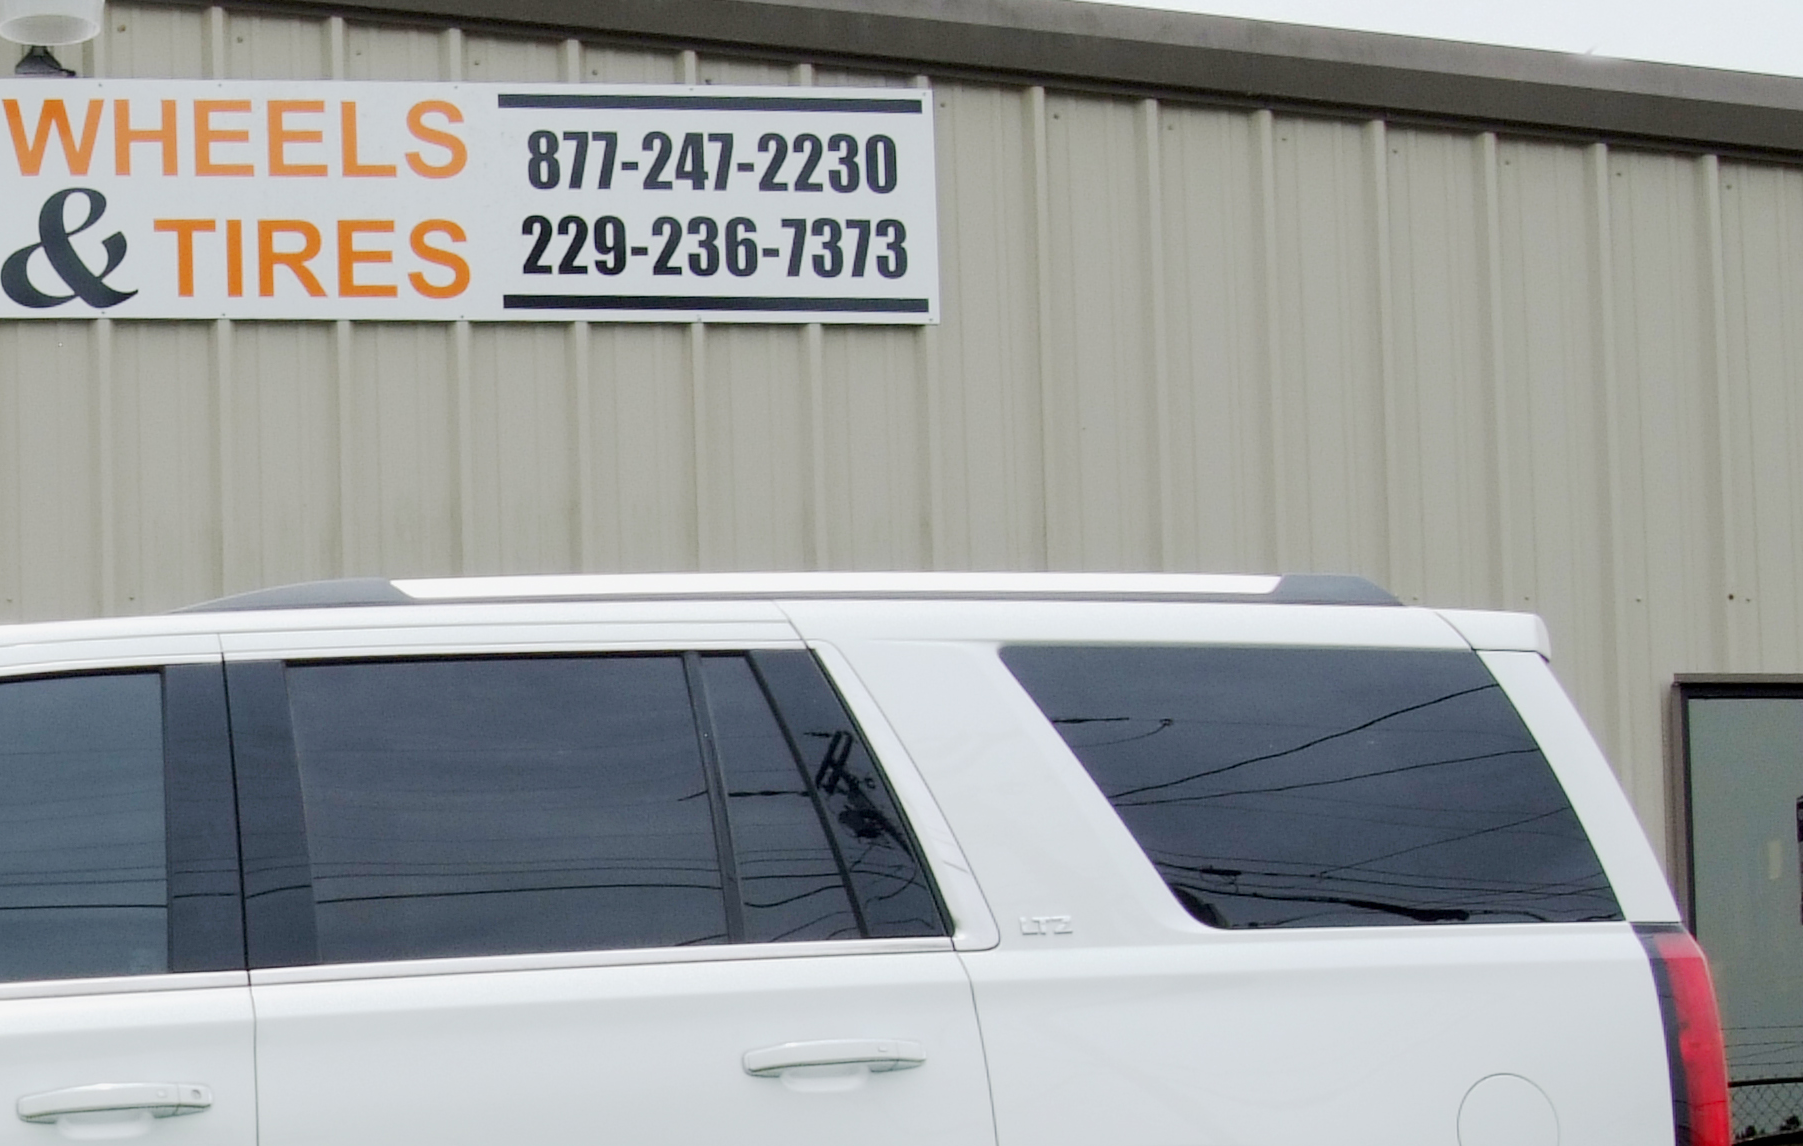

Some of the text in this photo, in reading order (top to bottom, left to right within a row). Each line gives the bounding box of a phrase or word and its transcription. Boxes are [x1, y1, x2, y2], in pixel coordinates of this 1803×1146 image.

[3, 98, 468, 178] WHEELS
[527, 130, 898, 194] 877-247-2230
[0, 187, 471, 309] & TIRES
[522, 215, 908, 279] 229-236-7373
[1020, 915, 1073, 936] LTZ
